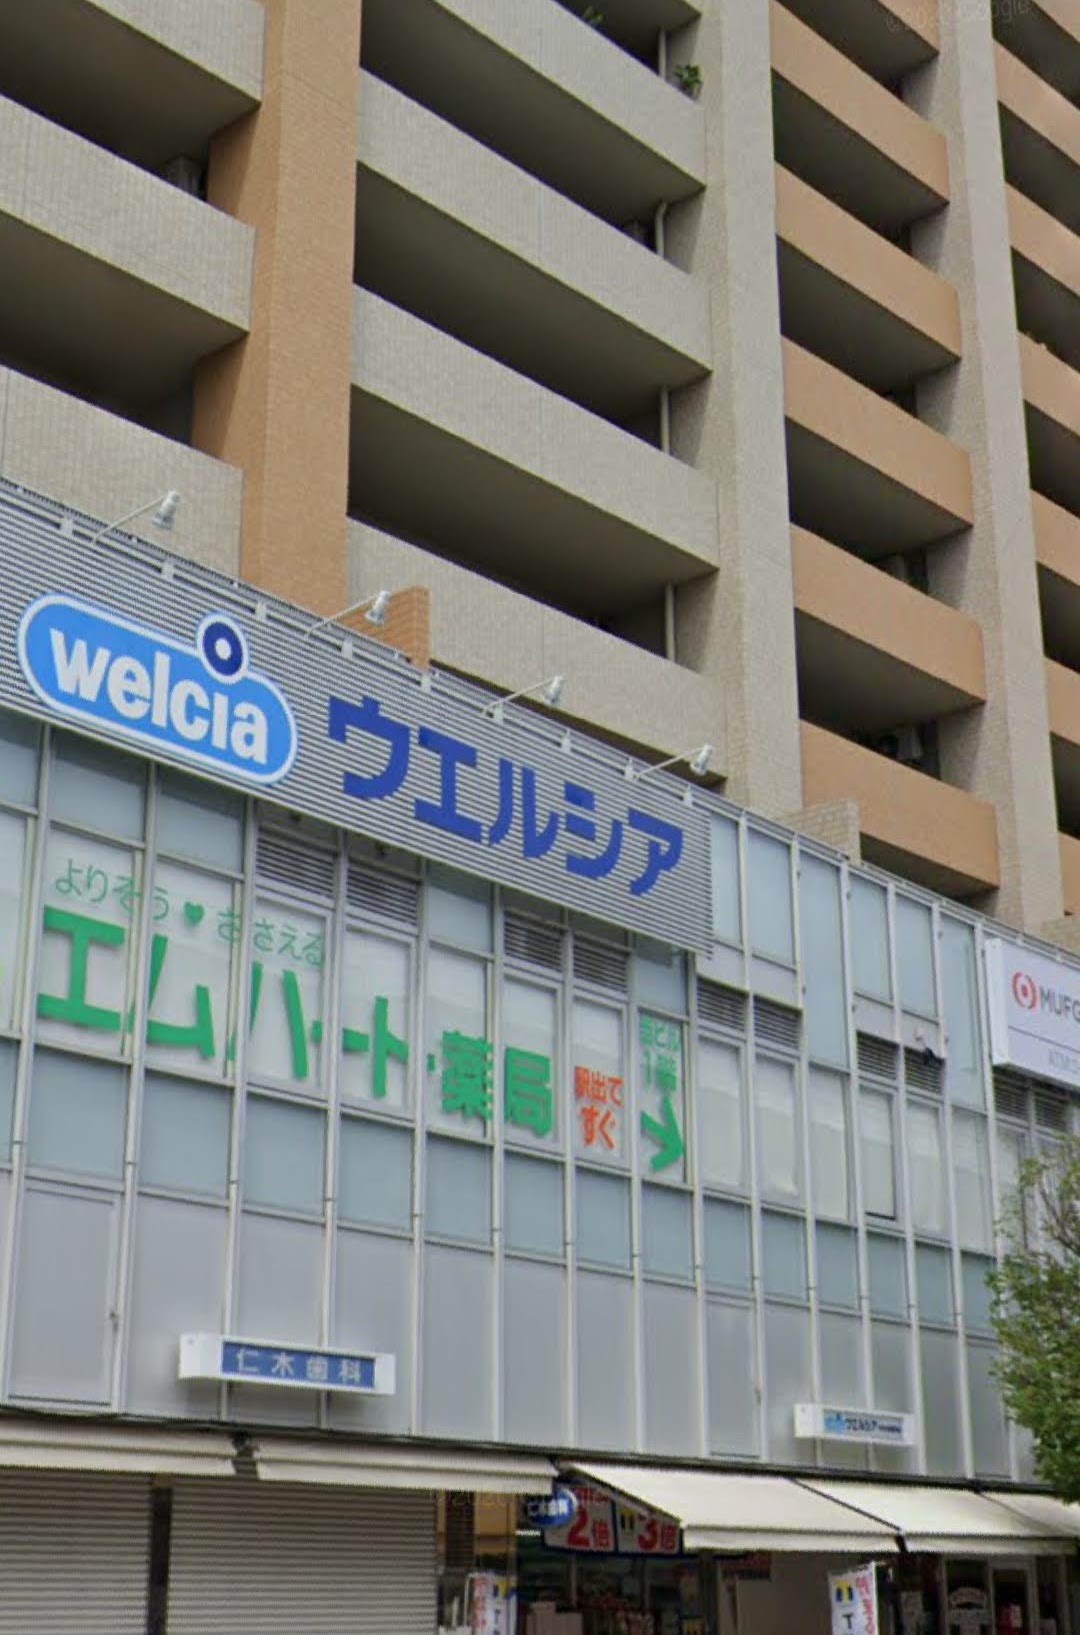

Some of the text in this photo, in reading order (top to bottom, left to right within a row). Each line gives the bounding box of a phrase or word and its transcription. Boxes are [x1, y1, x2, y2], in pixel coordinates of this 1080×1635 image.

[49, 625, 268, 766] welcia
[328, 694, 684, 896] ウエルシア
[236, 1347, 362, 1383] 仁木歯科
